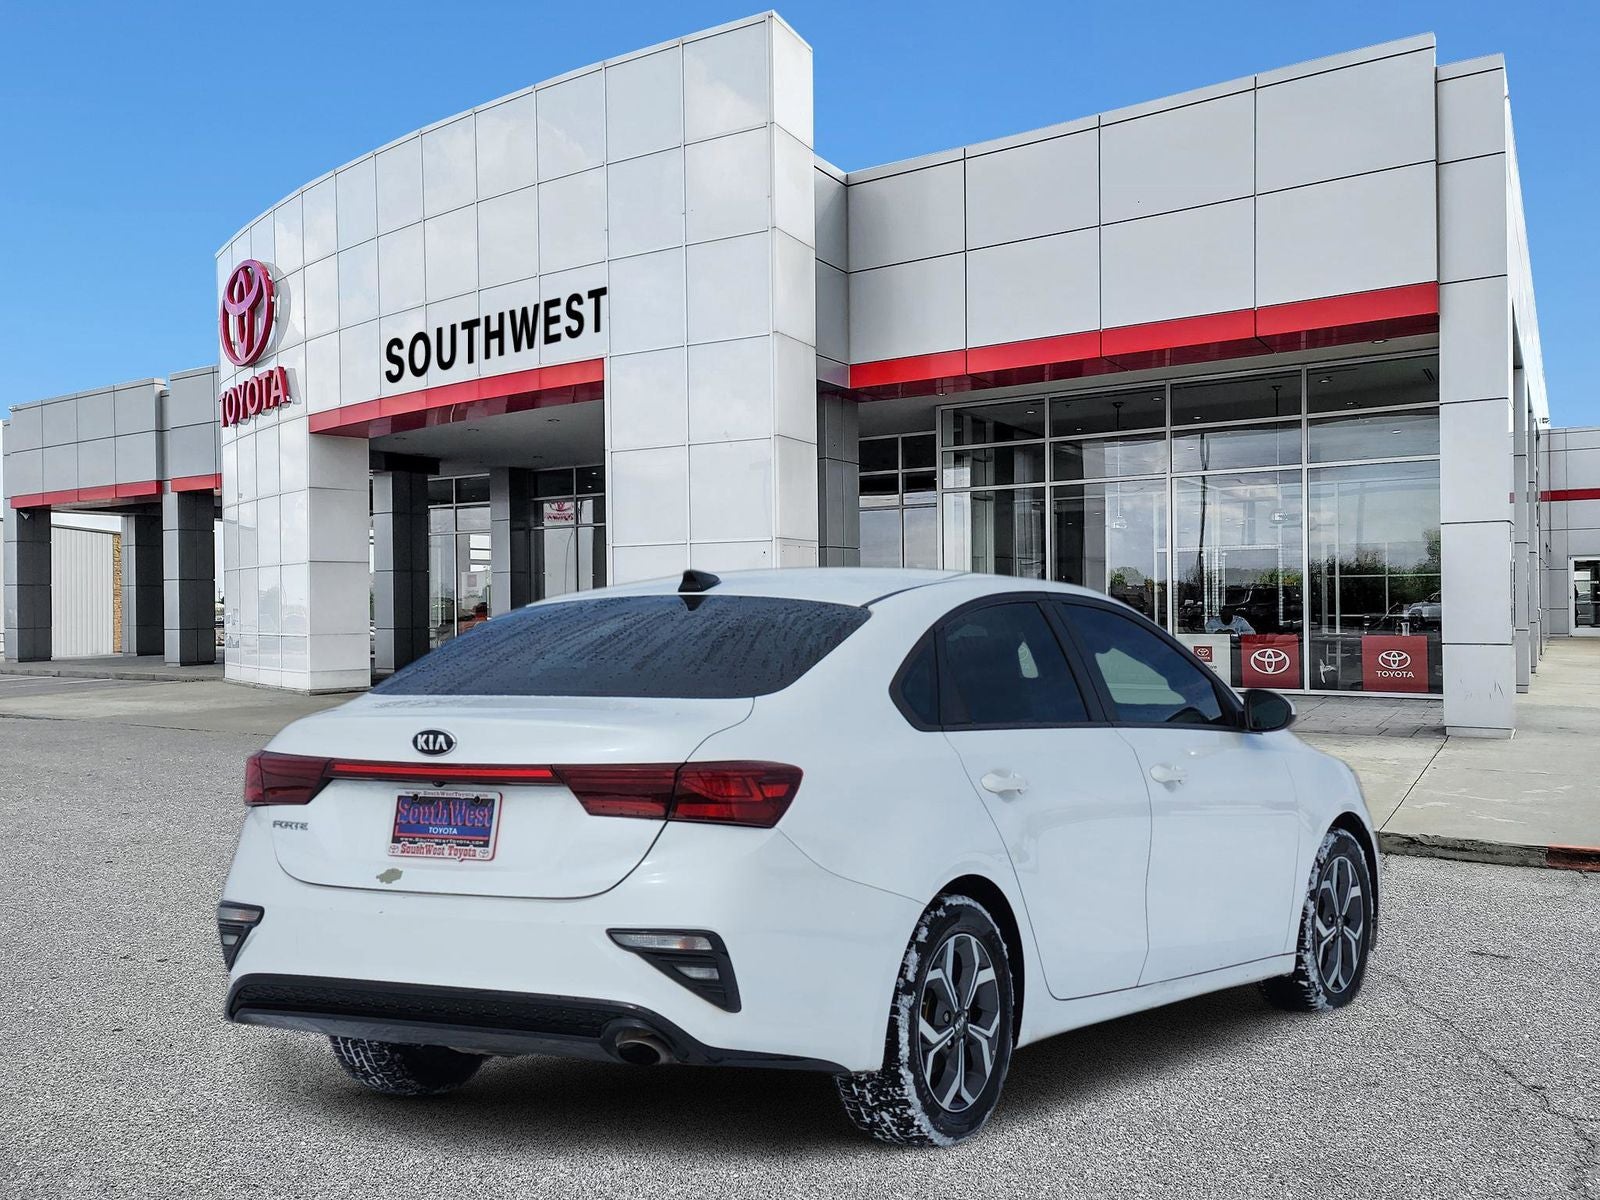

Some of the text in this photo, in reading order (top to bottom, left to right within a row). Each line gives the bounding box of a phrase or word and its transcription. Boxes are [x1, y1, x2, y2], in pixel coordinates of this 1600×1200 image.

[385, 286, 607, 384] SOUTHWEST
[219, 366, 291, 428] TOYOTA
[1376, 670, 1414, 678] TOYOTA
[417, 734, 448, 750] KIA
[272, 820, 308, 830] FORTE
[429, 826, 458, 835] TOYOTA
[400, 843, 476, 858] SouthWest Toyota
